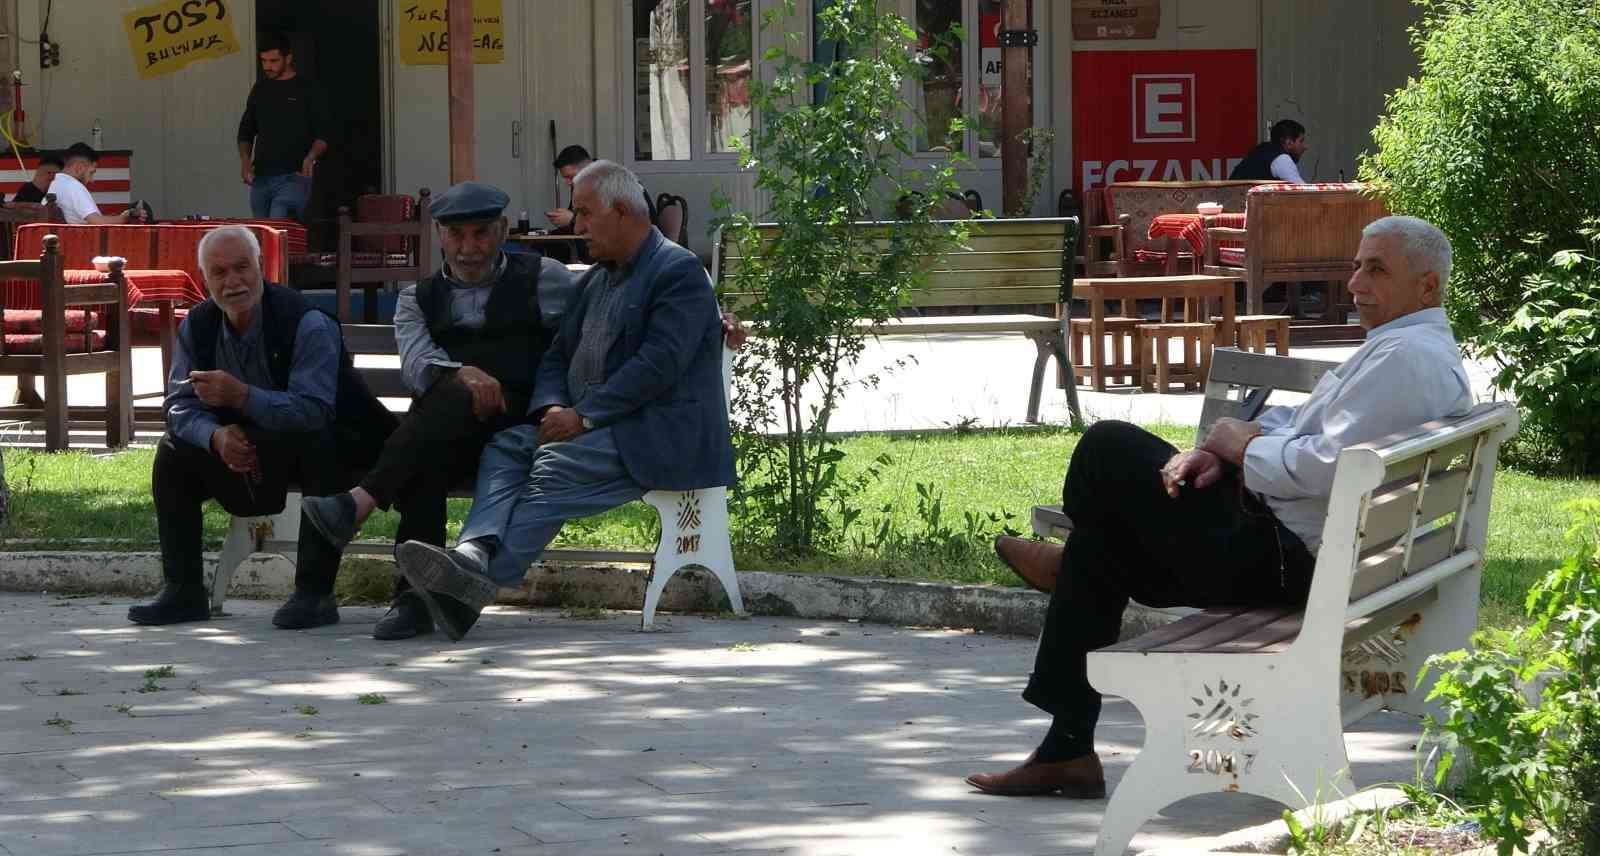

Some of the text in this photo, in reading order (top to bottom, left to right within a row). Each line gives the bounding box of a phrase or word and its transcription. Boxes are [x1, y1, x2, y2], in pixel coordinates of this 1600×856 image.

[1145, 83, 1184, 134] E
[676, 534, 701, 554] 2017
[1186, 749, 1256, 775] 2017
